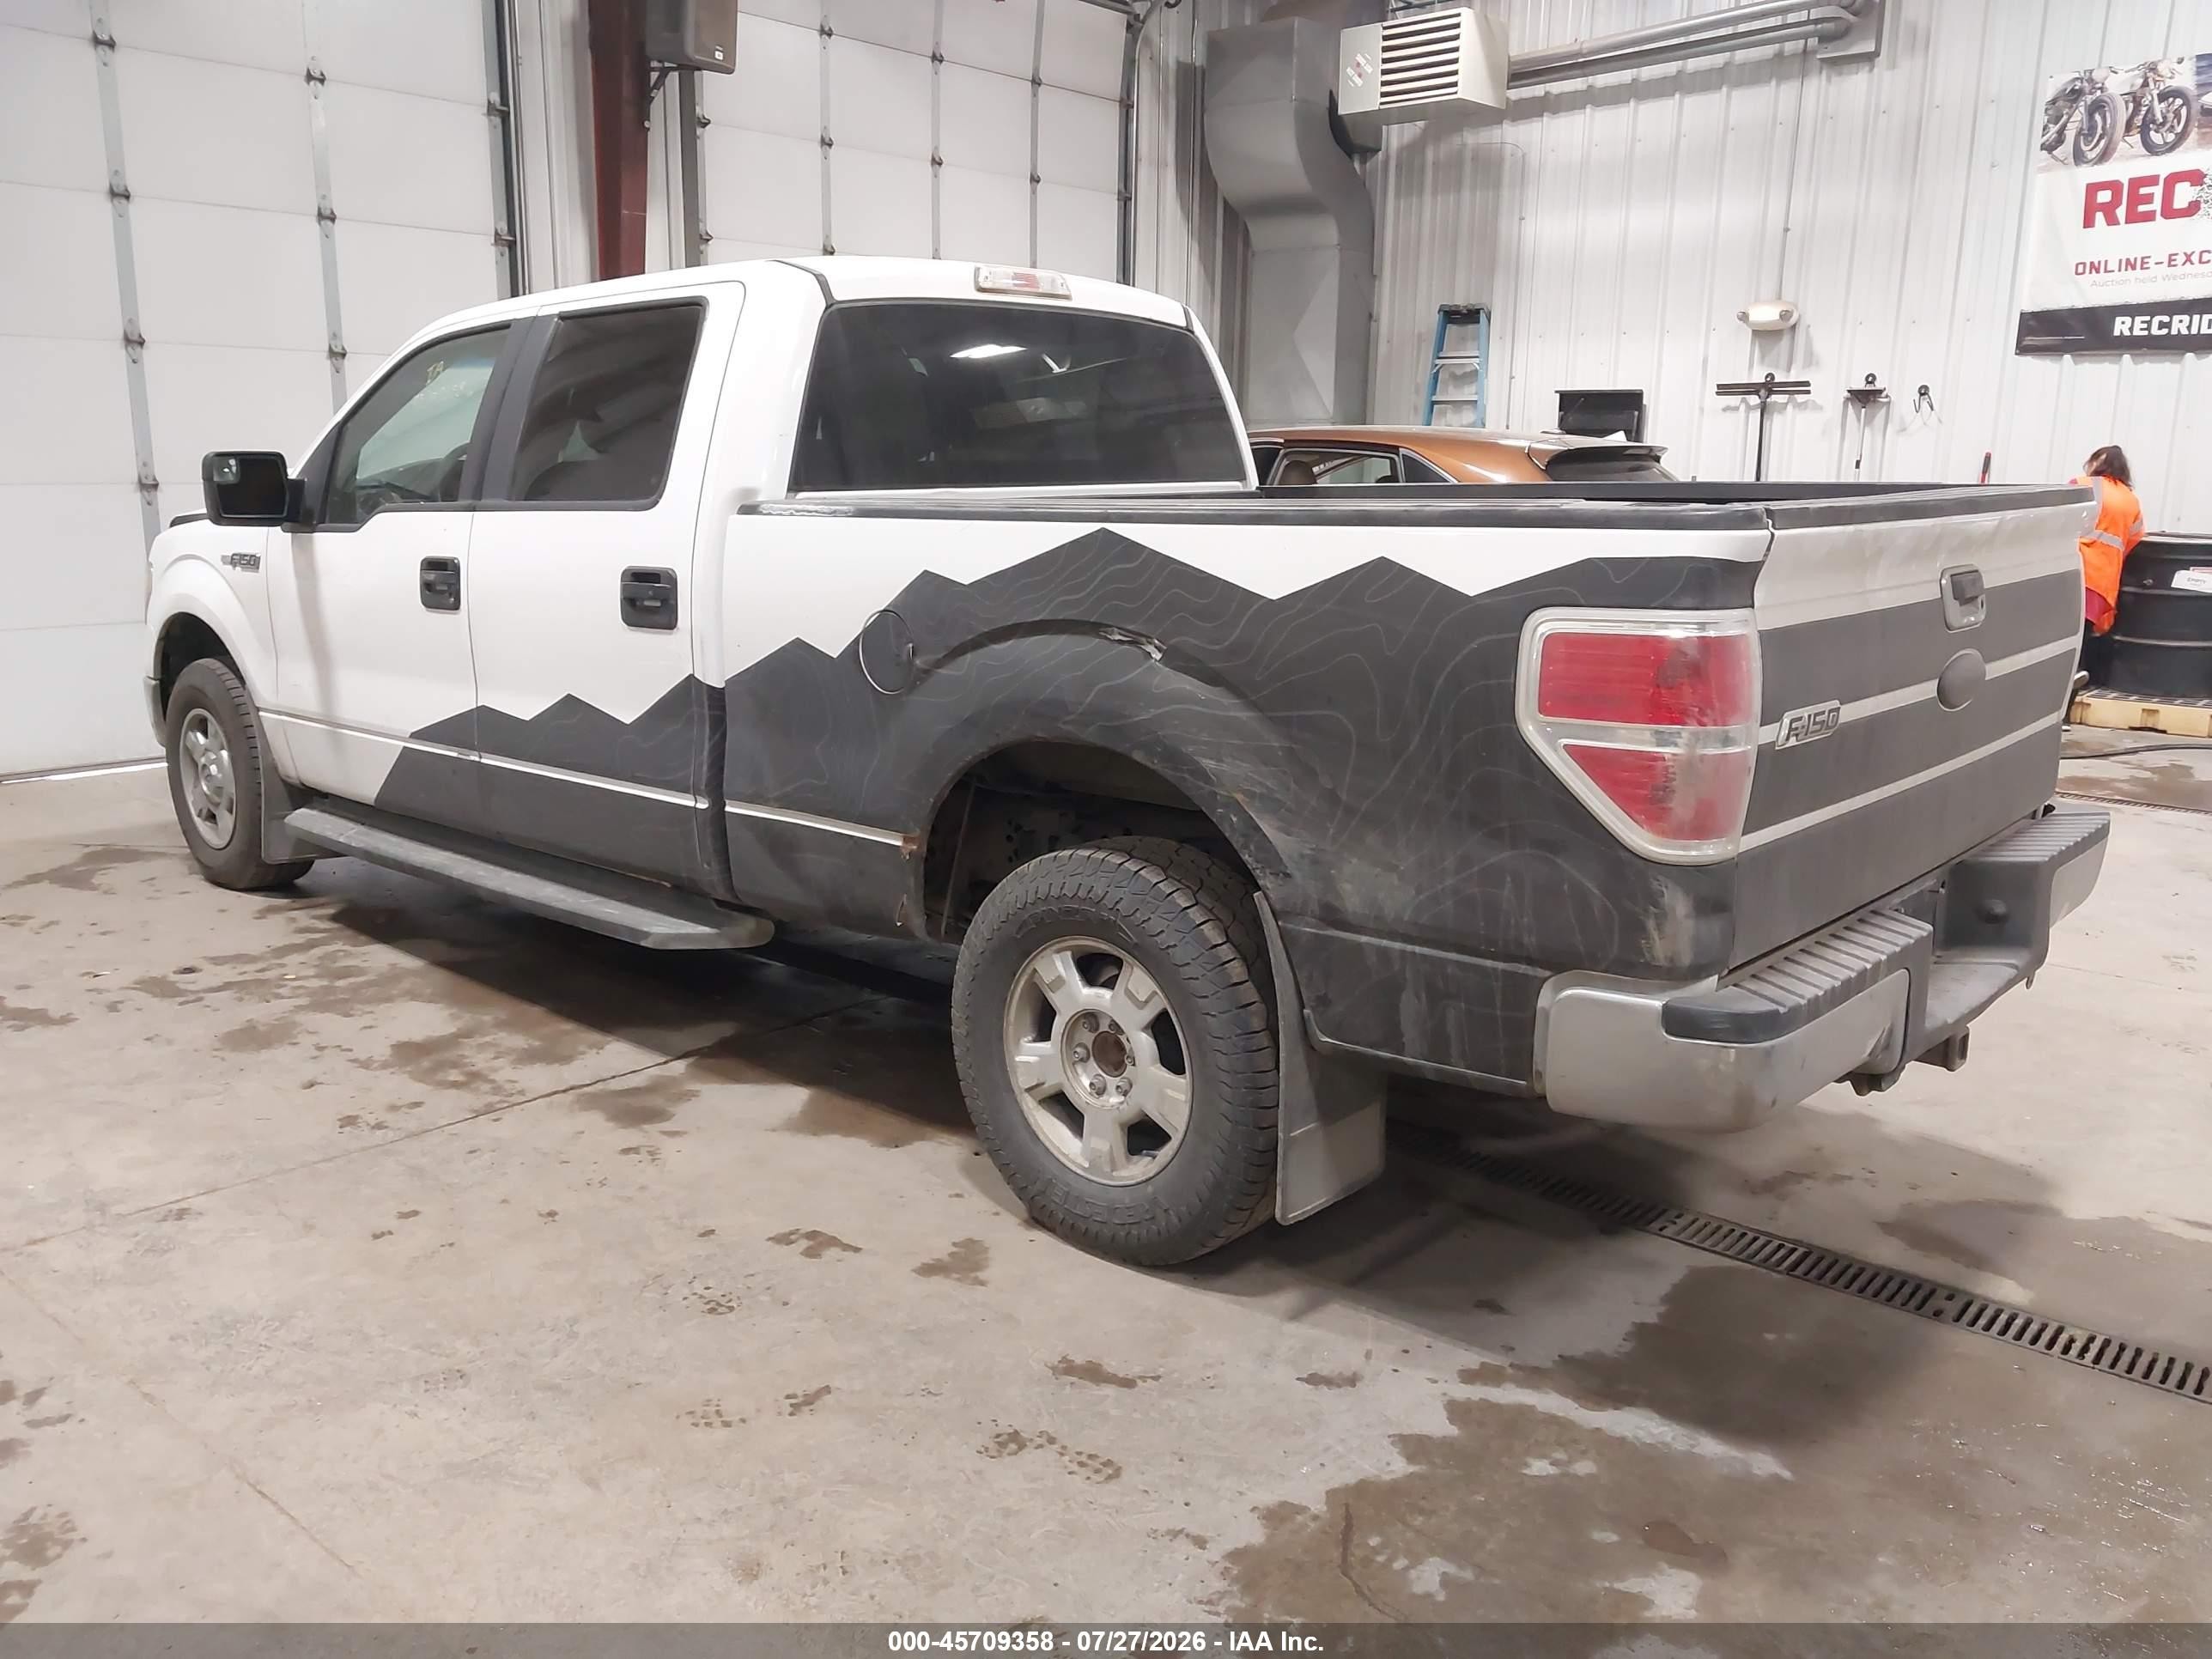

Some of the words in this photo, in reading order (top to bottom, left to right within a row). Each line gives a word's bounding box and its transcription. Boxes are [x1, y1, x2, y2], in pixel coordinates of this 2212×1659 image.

[2083, 169, 2206, 228] REC
[2090, 278, 2131, 288] Auction
[2135, 275, 2158, 284] held
[1785, 707, 1841, 742] F-150
